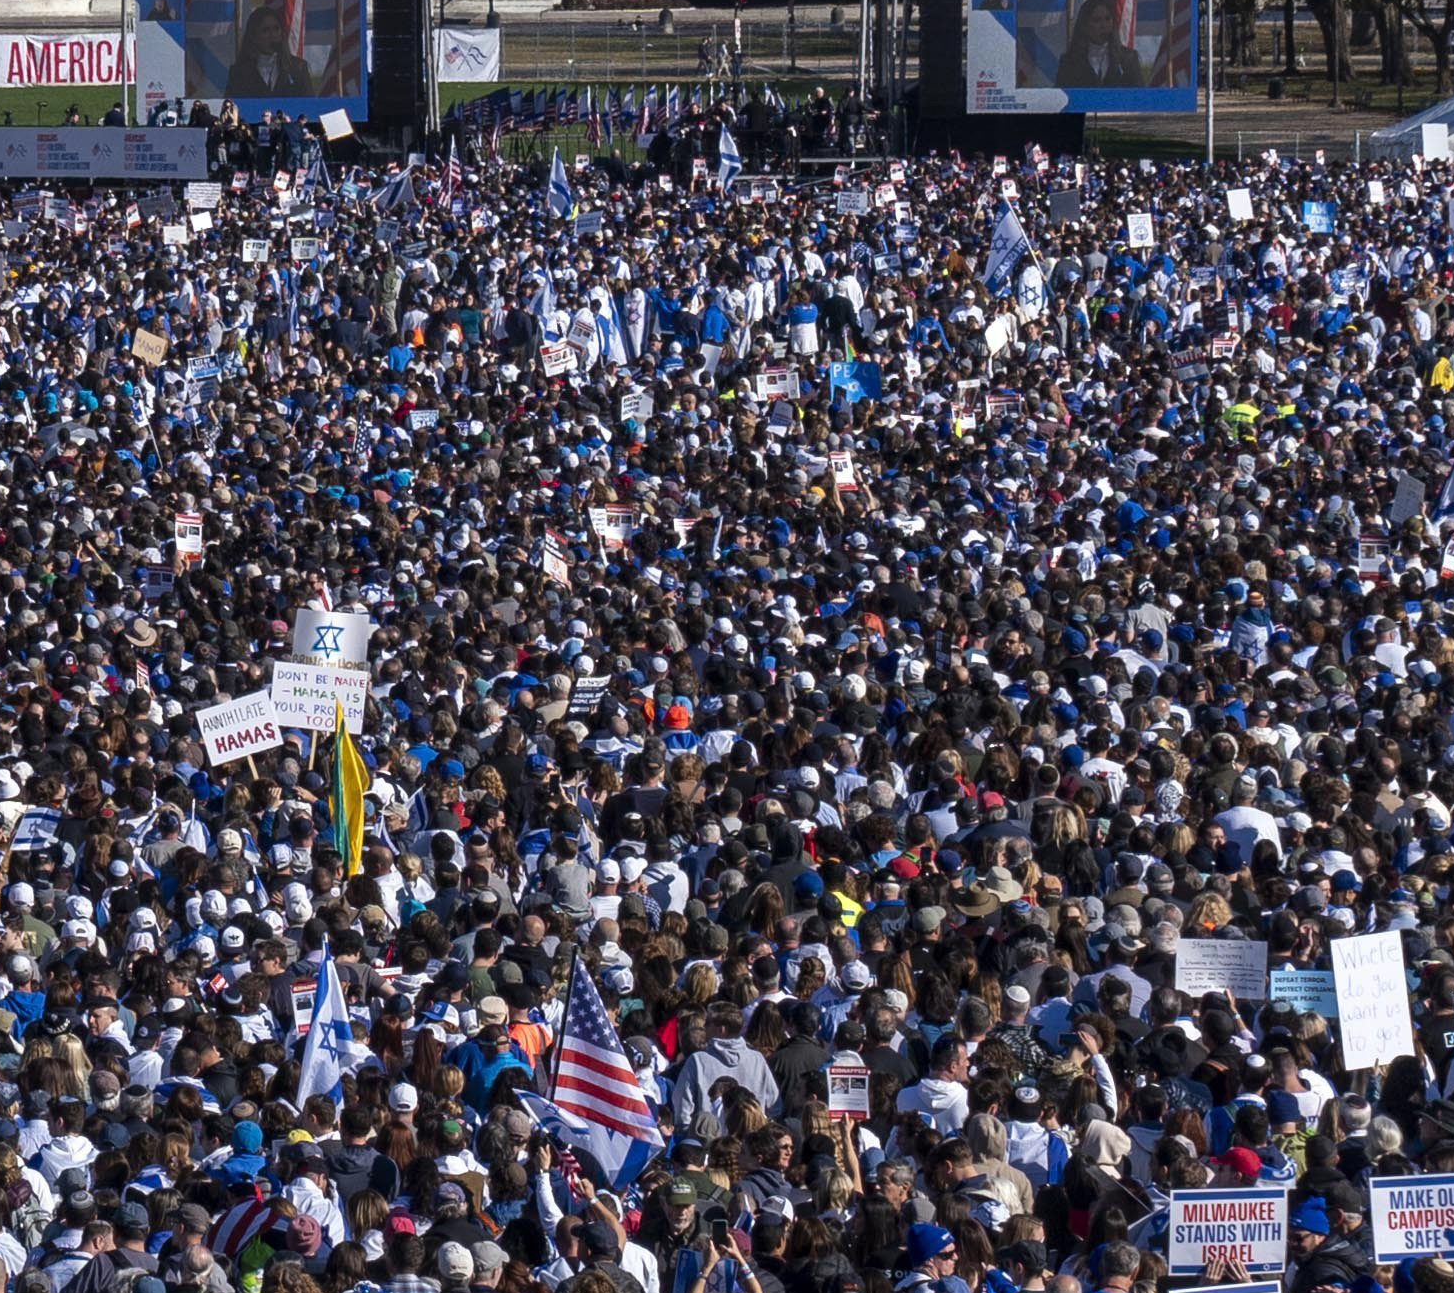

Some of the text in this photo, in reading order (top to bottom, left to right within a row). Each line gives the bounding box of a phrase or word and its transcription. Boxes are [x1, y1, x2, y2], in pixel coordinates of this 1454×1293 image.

[6, 40, 136, 84] AMERICA
[277, 670, 365, 688] DON'T BE NAIVE
[293, 686, 361, 704] HAMAS IS
[202, 701, 266, 734] ANNIHILATE
[274, 700, 363, 719] YOUR PROLEM
[305, 715, 335, 729] TOO
[215, 722, 276, 754] HAMAS
[1336, 938, 1400, 970] Where
[1343, 973, 1398, 1000] do you
[1340, 1003, 1401, 1023] want us
[1348, 1024, 1400, 1054] to go?
[1390, 1188, 1434, 1210] MAKE
[1182, 1202, 1275, 1223] MILWAUKEE
[1175, 1223, 1281, 1244] STANDS WITH
[1405, 1228, 1442, 1250] SAFE
[1201, 1244, 1255, 1263] ISRAEL
